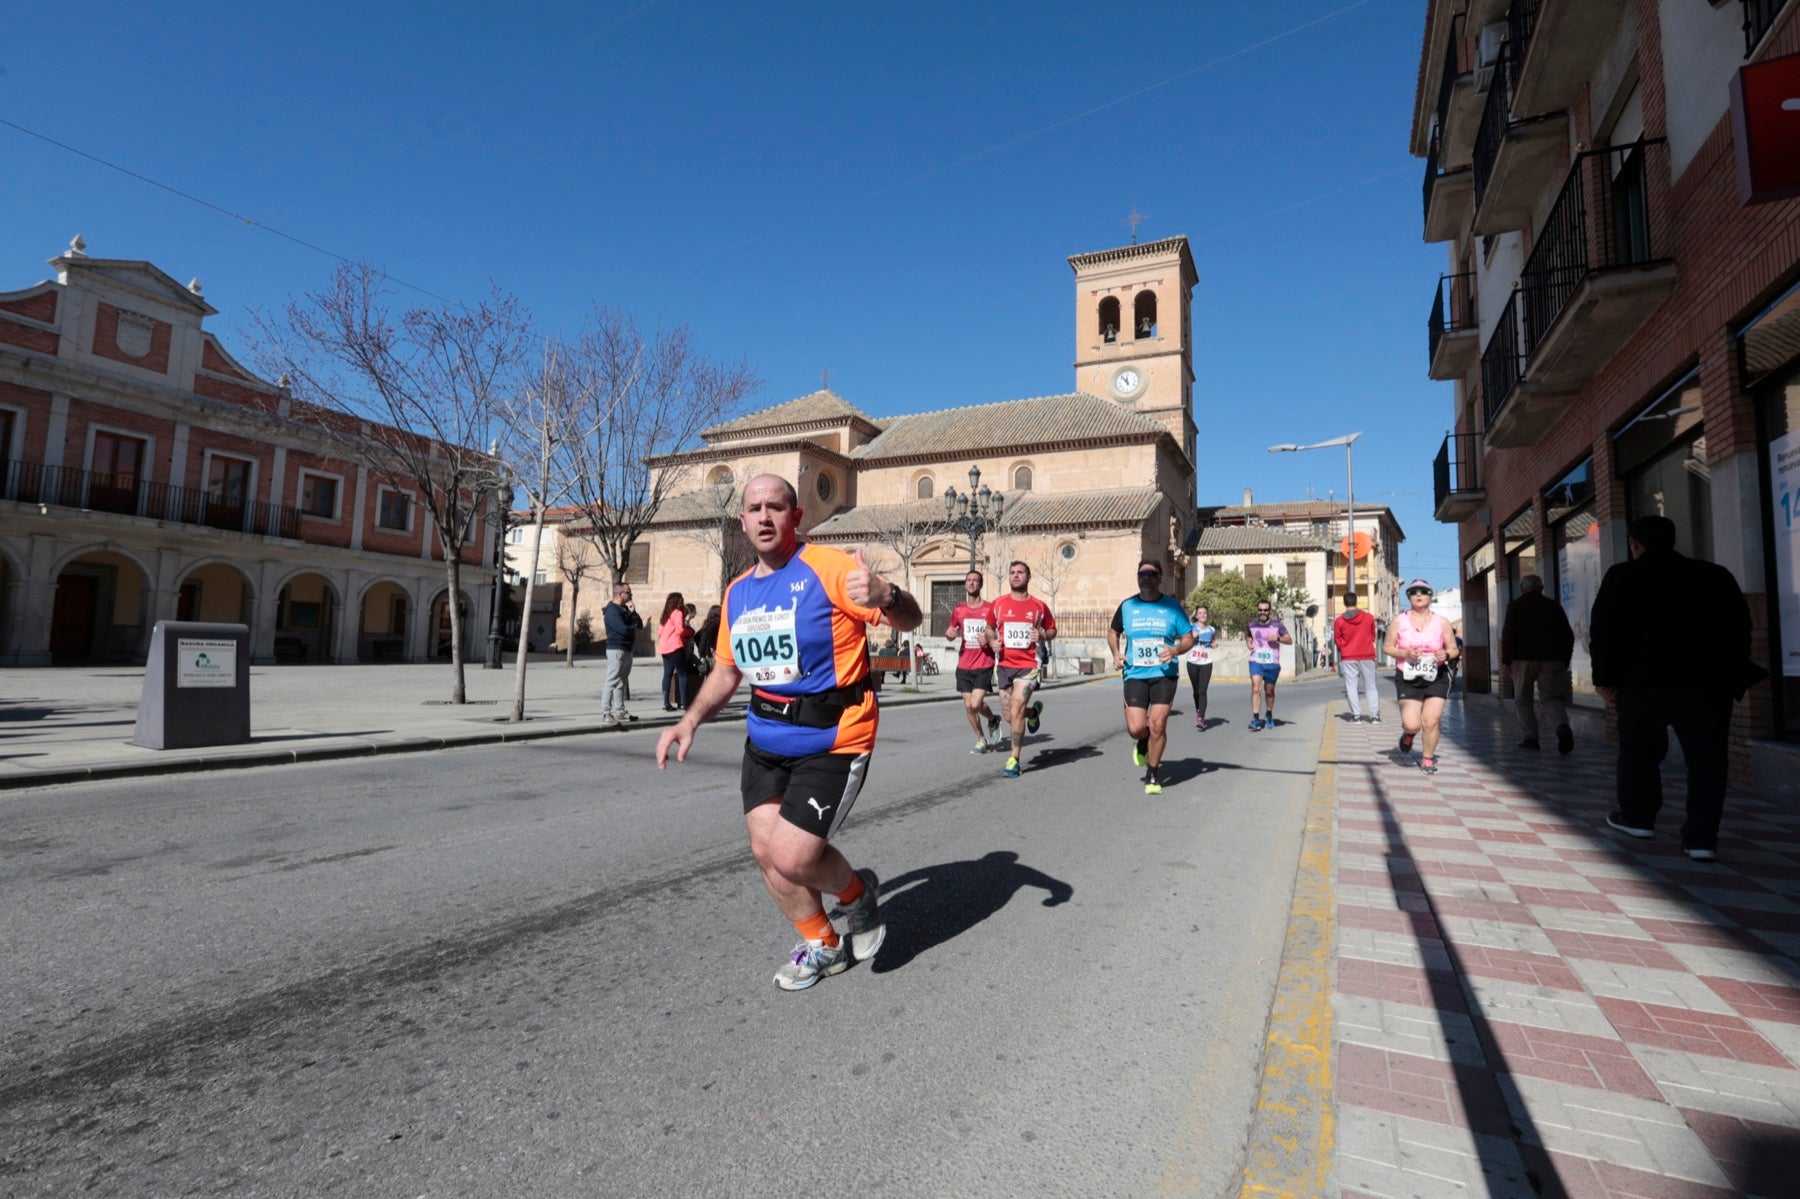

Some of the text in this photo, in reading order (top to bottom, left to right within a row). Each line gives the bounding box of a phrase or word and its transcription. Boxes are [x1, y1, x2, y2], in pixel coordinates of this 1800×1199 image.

[966, 625, 985, 634] 3146
[1007, 630, 1030, 640] 3032
[735, 634, 794, 663] 1045
[1138, 646, 1159, 658] 381
